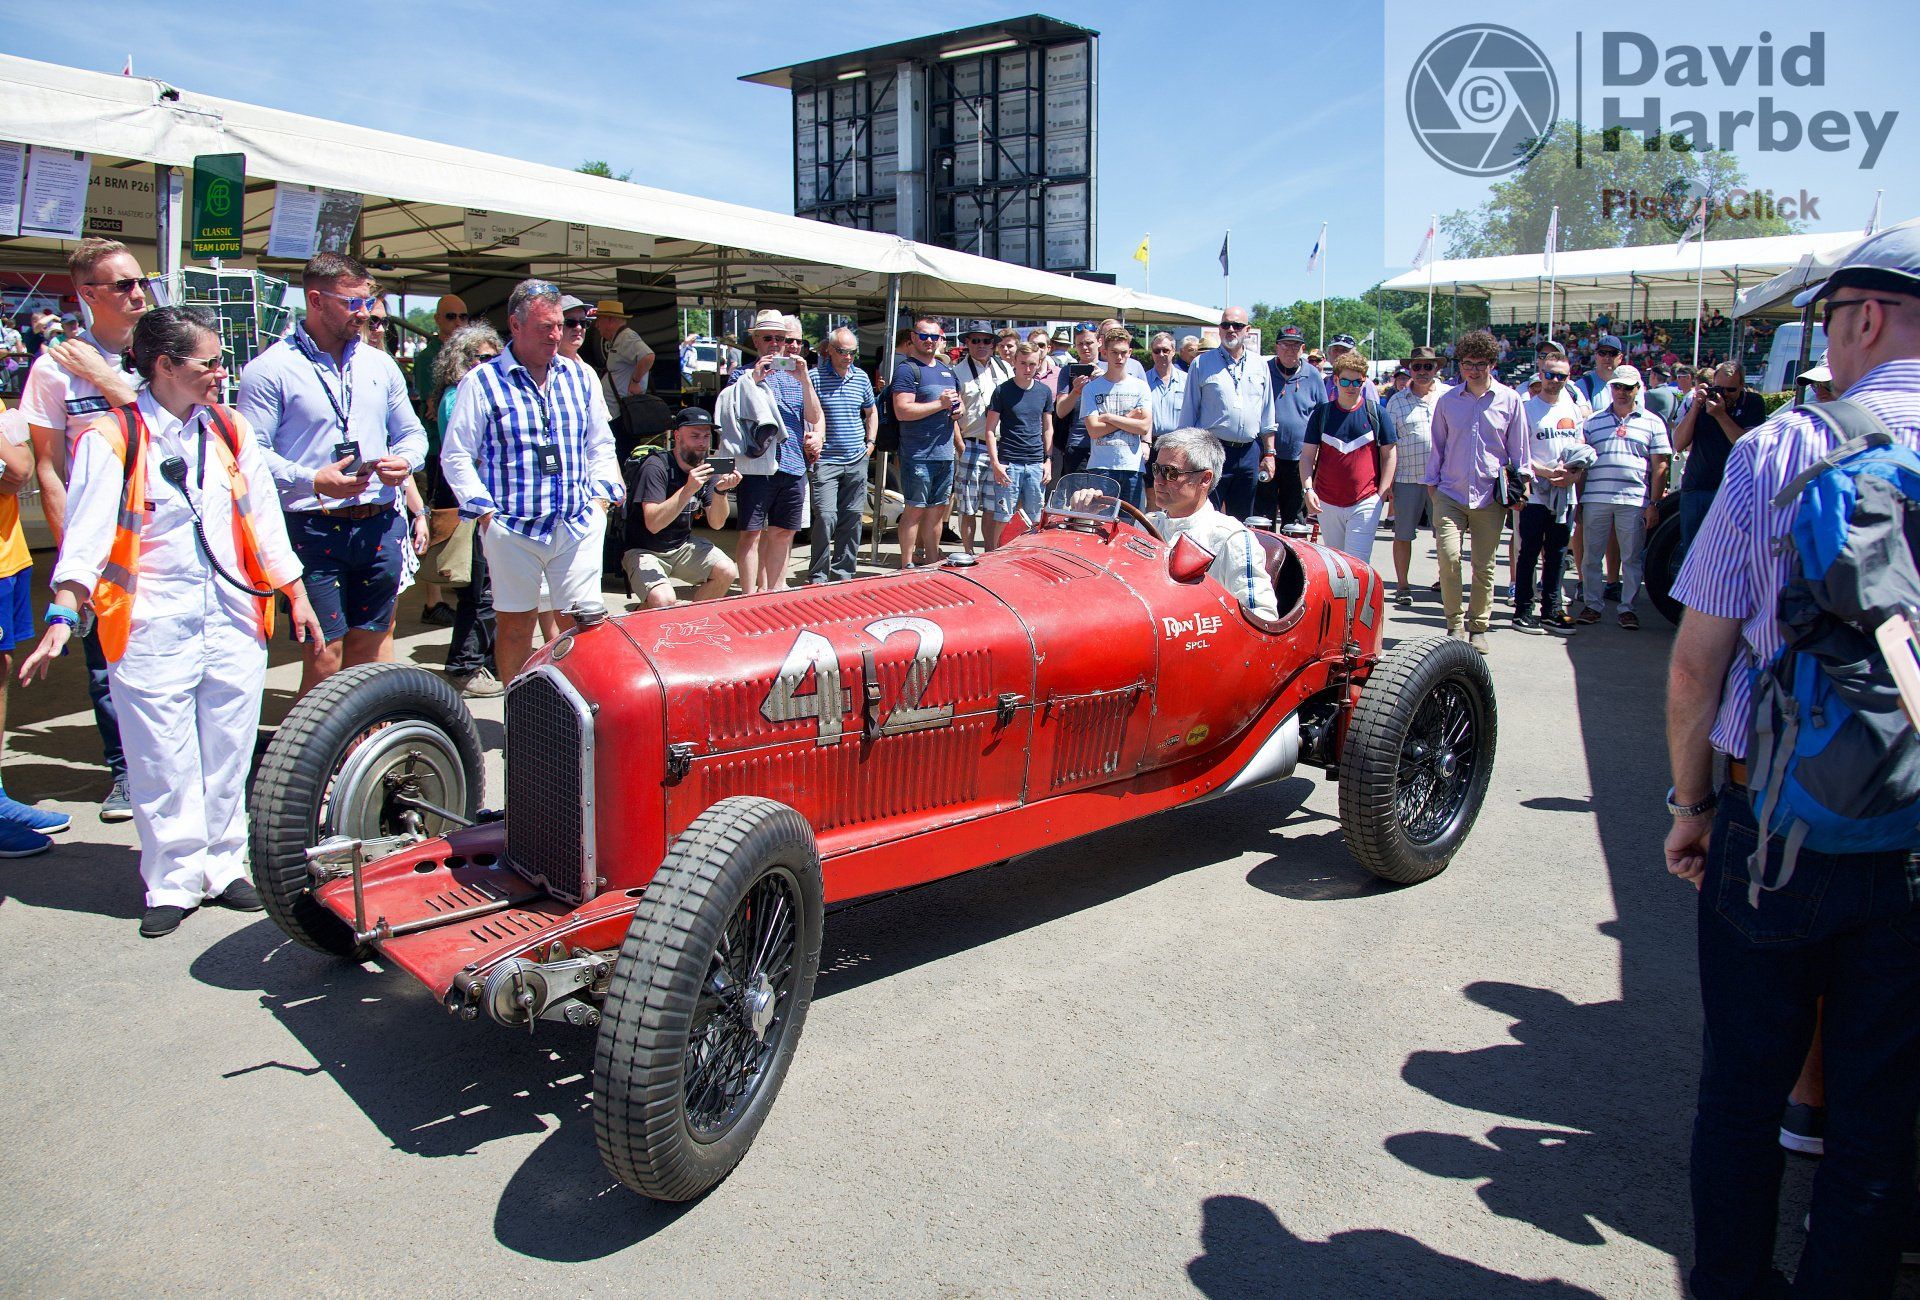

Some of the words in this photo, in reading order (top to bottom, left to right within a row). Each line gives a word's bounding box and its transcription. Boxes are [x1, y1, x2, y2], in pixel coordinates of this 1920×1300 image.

[105, 177, 128, 189] BRM
[131, 180, 154, 192] P261
[91, 219, 121, 230] sports
[202, 227, 232, 237] CLASSIC
[194, 243, 214, 252] TEAM
[215, 242, 240, 251] LOTUS
[1194, 612, 1223, 636] LEE
[1185, 640, 1211, 651] SPCL.
[759, 616, 954, 746] 42
